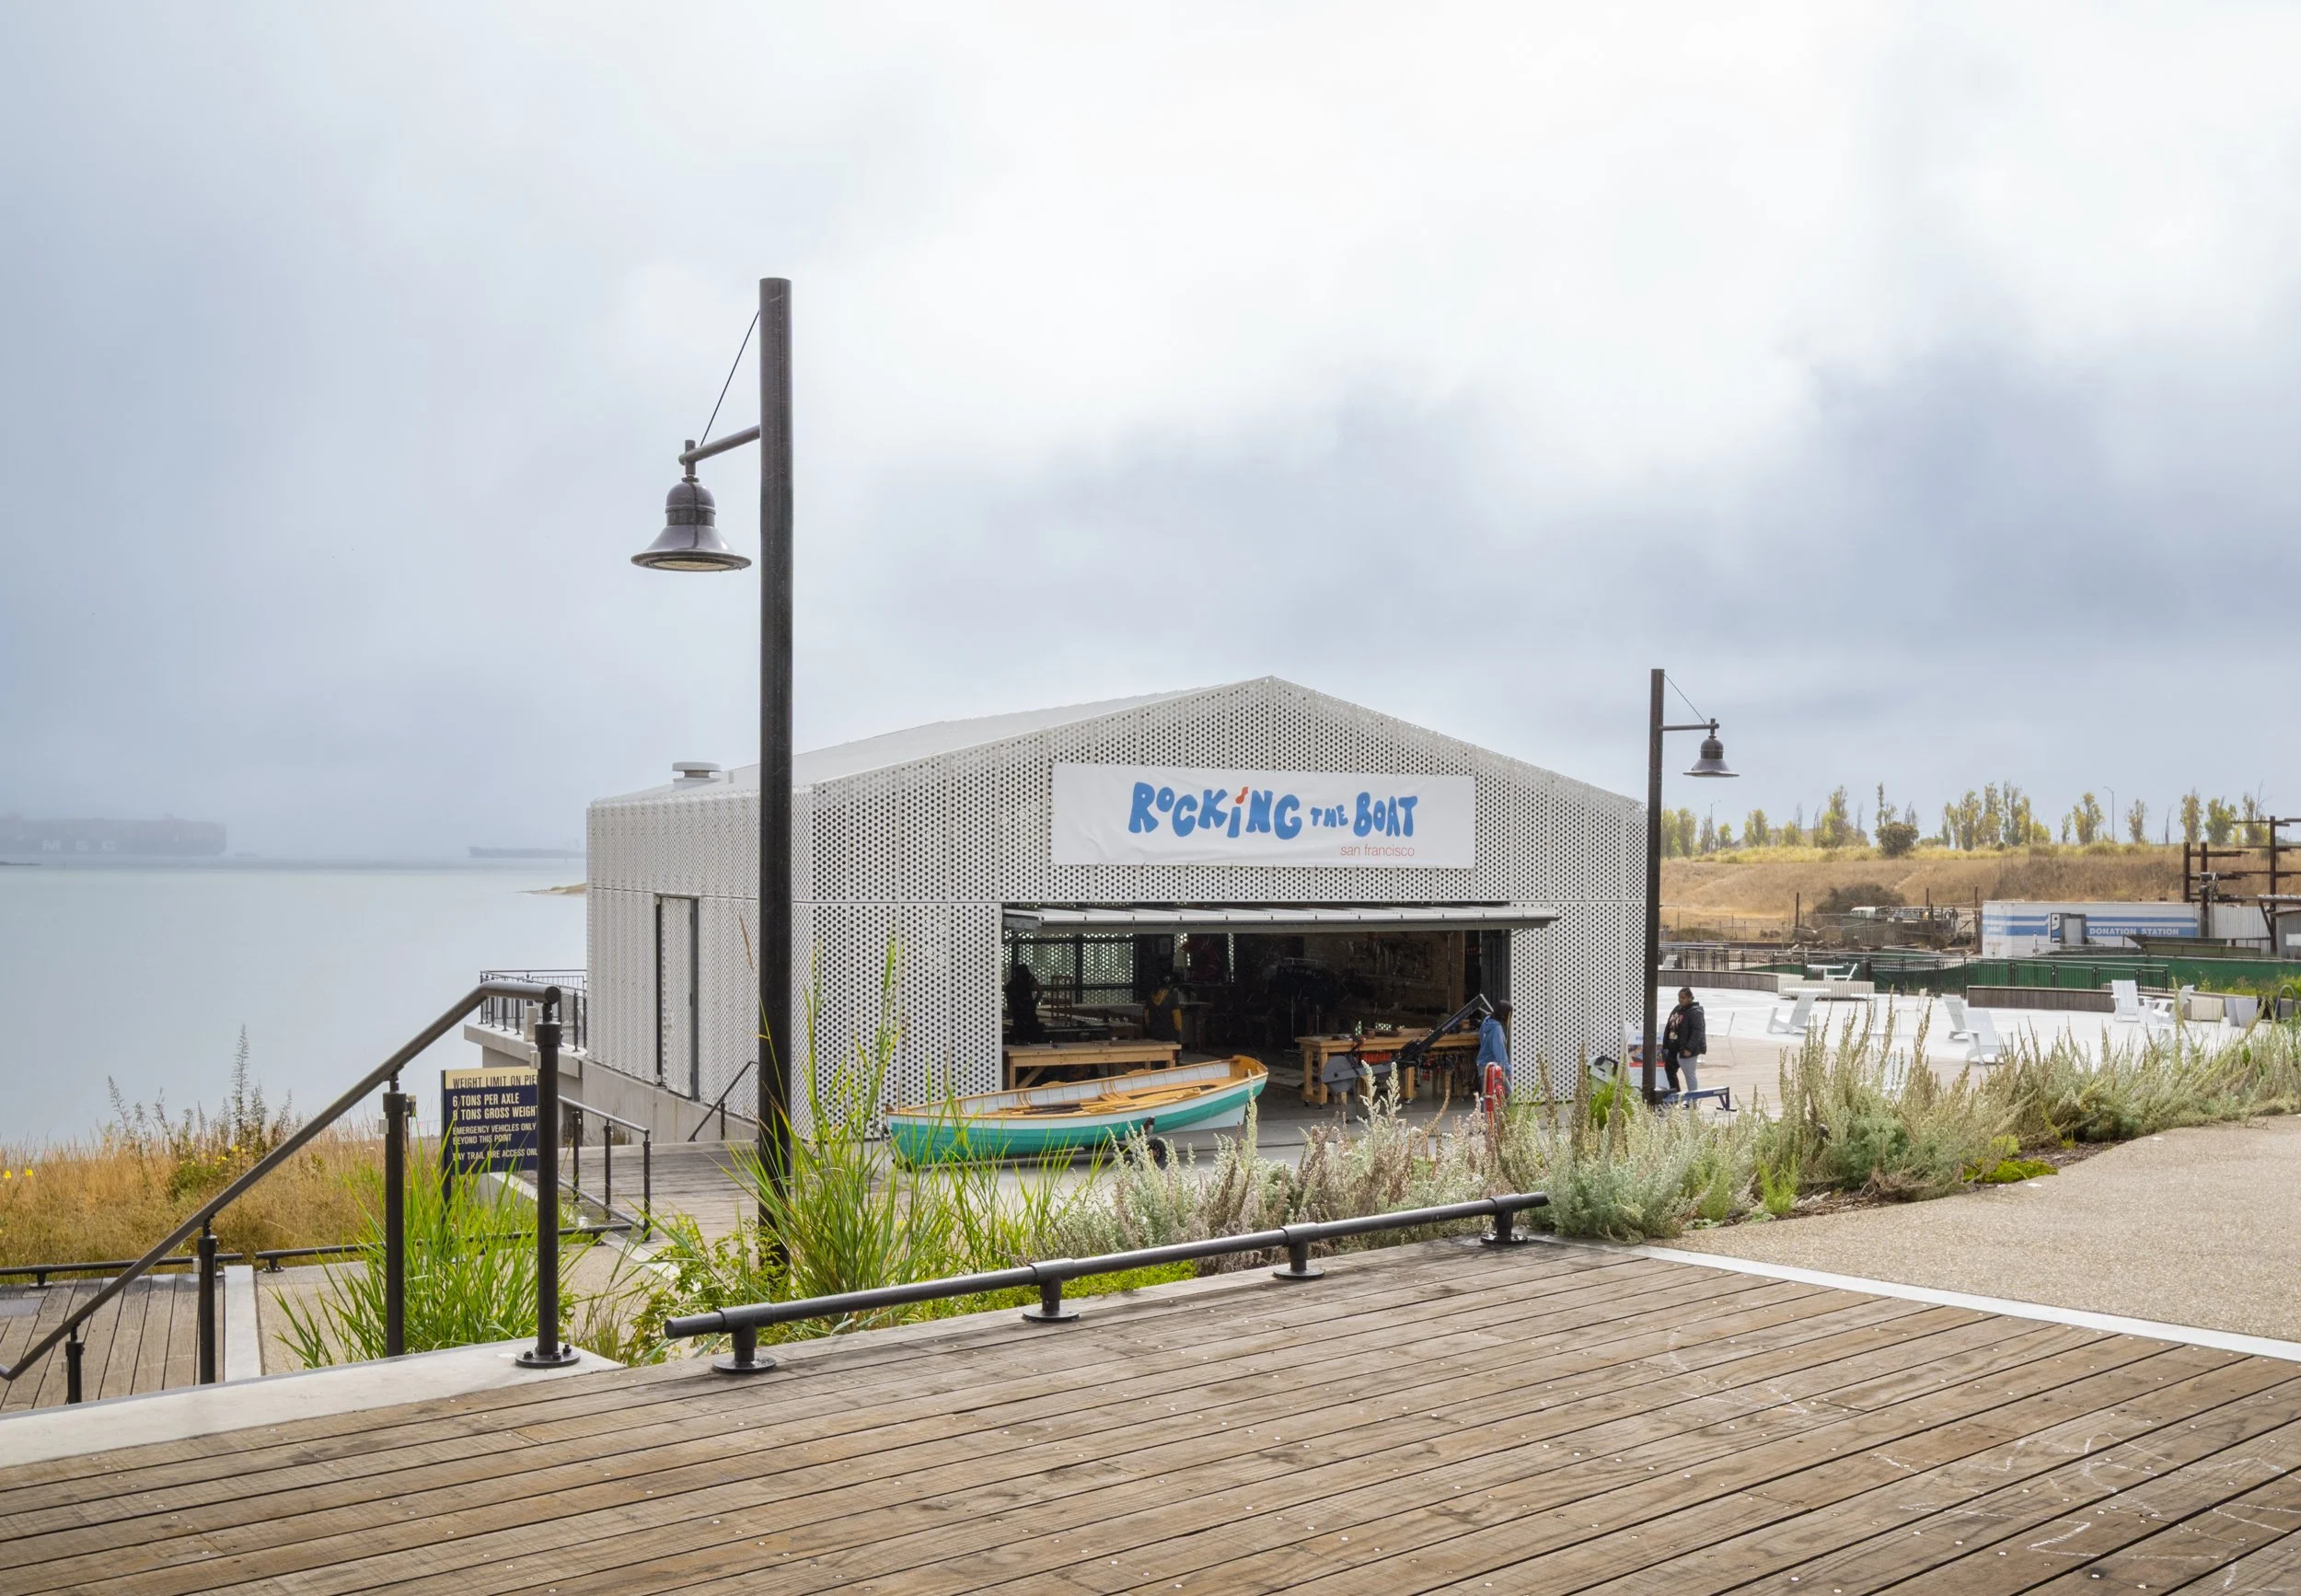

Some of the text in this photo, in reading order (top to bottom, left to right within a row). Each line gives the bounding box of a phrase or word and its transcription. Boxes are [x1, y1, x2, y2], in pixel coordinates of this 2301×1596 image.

[1310, 804, 1348, 827] THE
[1353, 792, 1418, 838] BOAT
[42, 839, 116, 851] MSC
[1340, 843, 1415, 857] san francisco
[2089, 927, 2180, 936] DONATION STATION
[453, 1074, 538, 1089] WEIGHT LIMIT ON PIE
[452, 1093, 520, 1107] 6 TONS PER AXLE
[461, 1108, 481, 1120] TONS
[484, 1107, 510, 1119] GROSS
[453, 1122, 537, 1135] EMERGENCY VEHICLES ONLY
[453, 1133, 512, 1145] BEYOND THIS POINT
[467, 1151, 485, 1160] TRAIL
[502, 1148, 525, 1158] ACCESS
[526, 1148, 538, 1156] ONL
